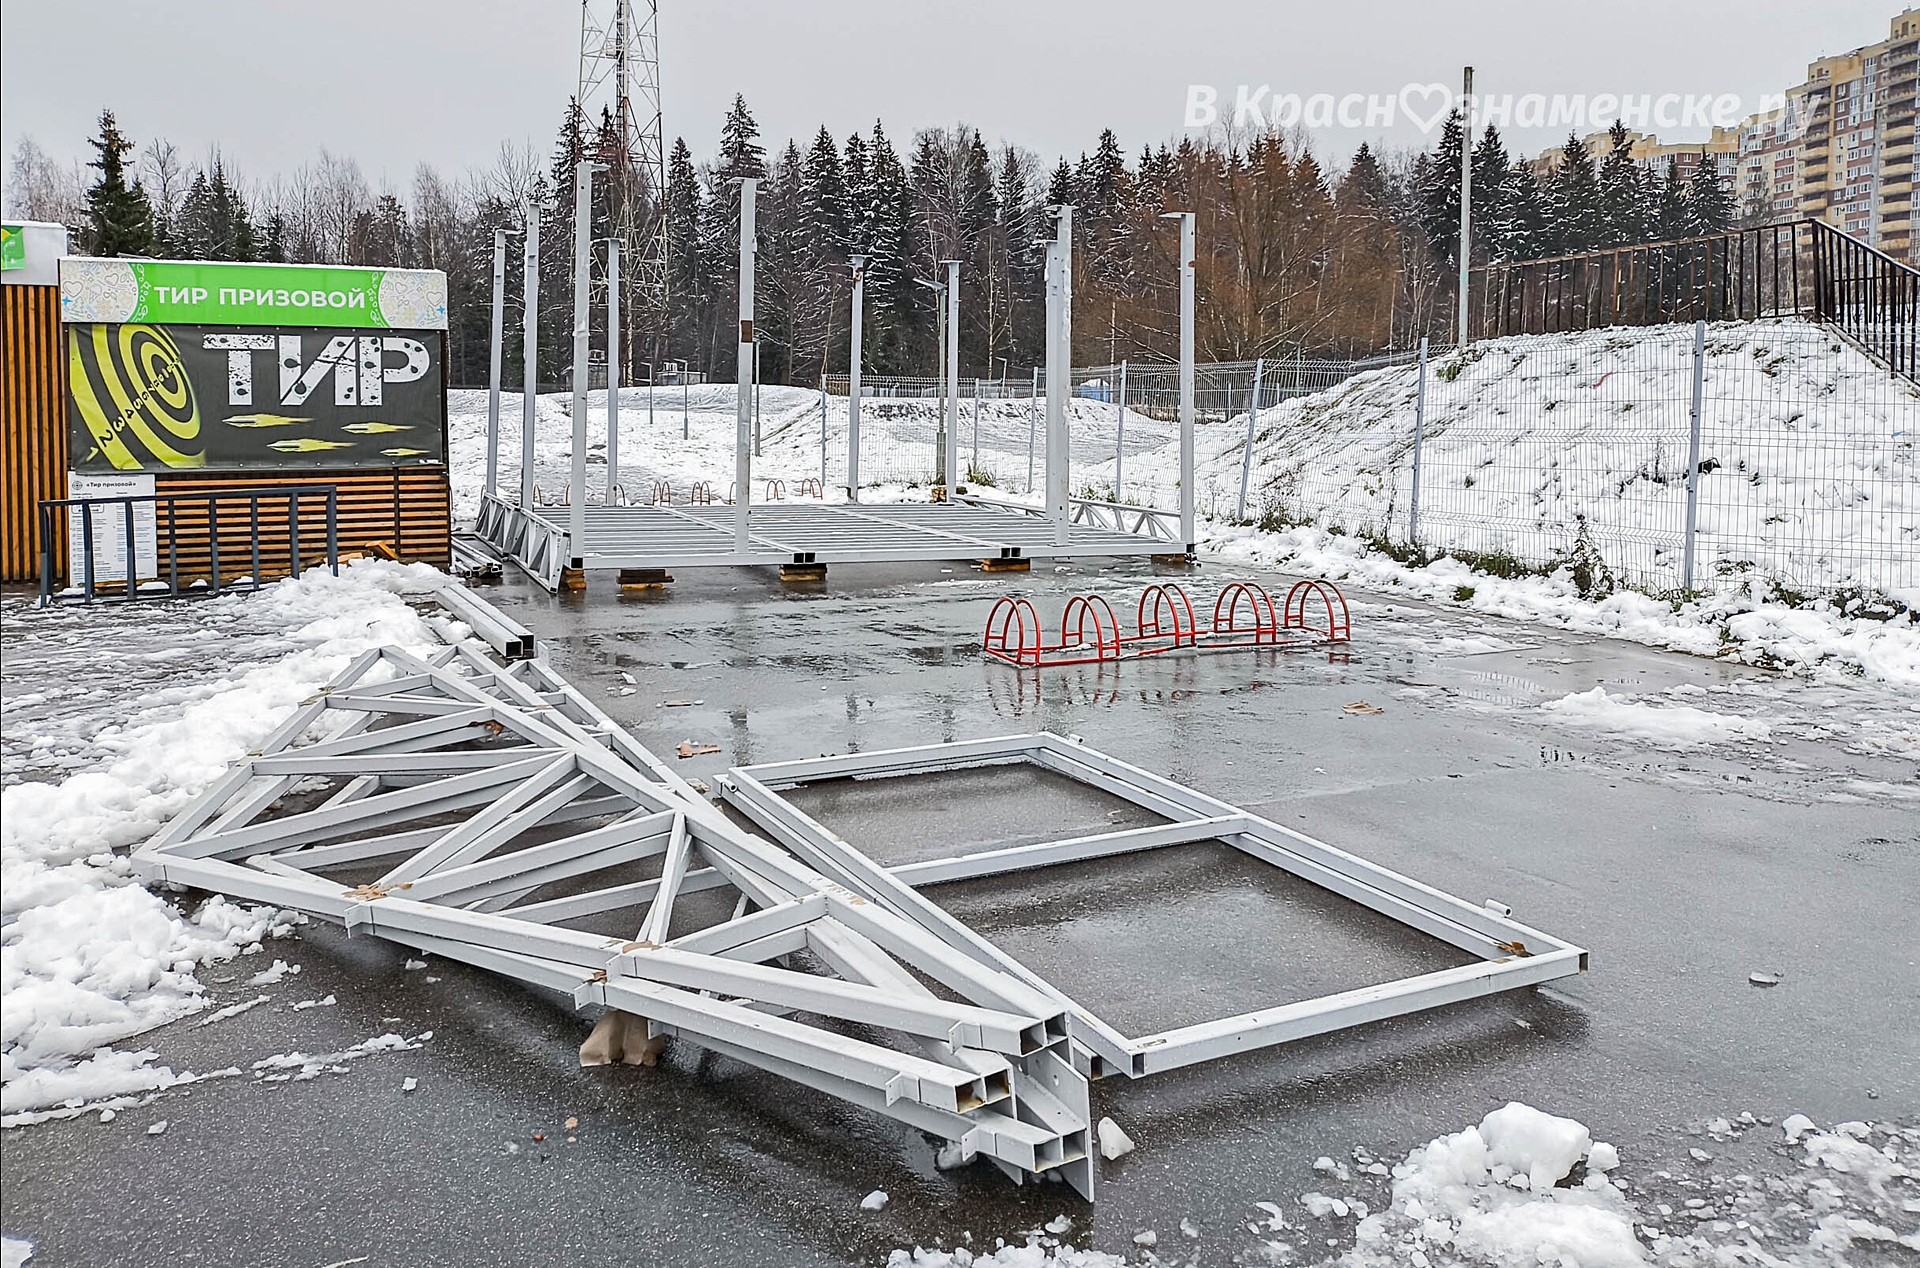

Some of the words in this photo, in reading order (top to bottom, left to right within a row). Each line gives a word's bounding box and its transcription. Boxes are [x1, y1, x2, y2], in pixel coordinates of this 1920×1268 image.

[154, 286, 208, 305] ТИР
[219, 287, 366, 309] ПРИЗОВОЙ
[202, 333, 431, 407] ТИР
[99, 429, 114, 448] 2
